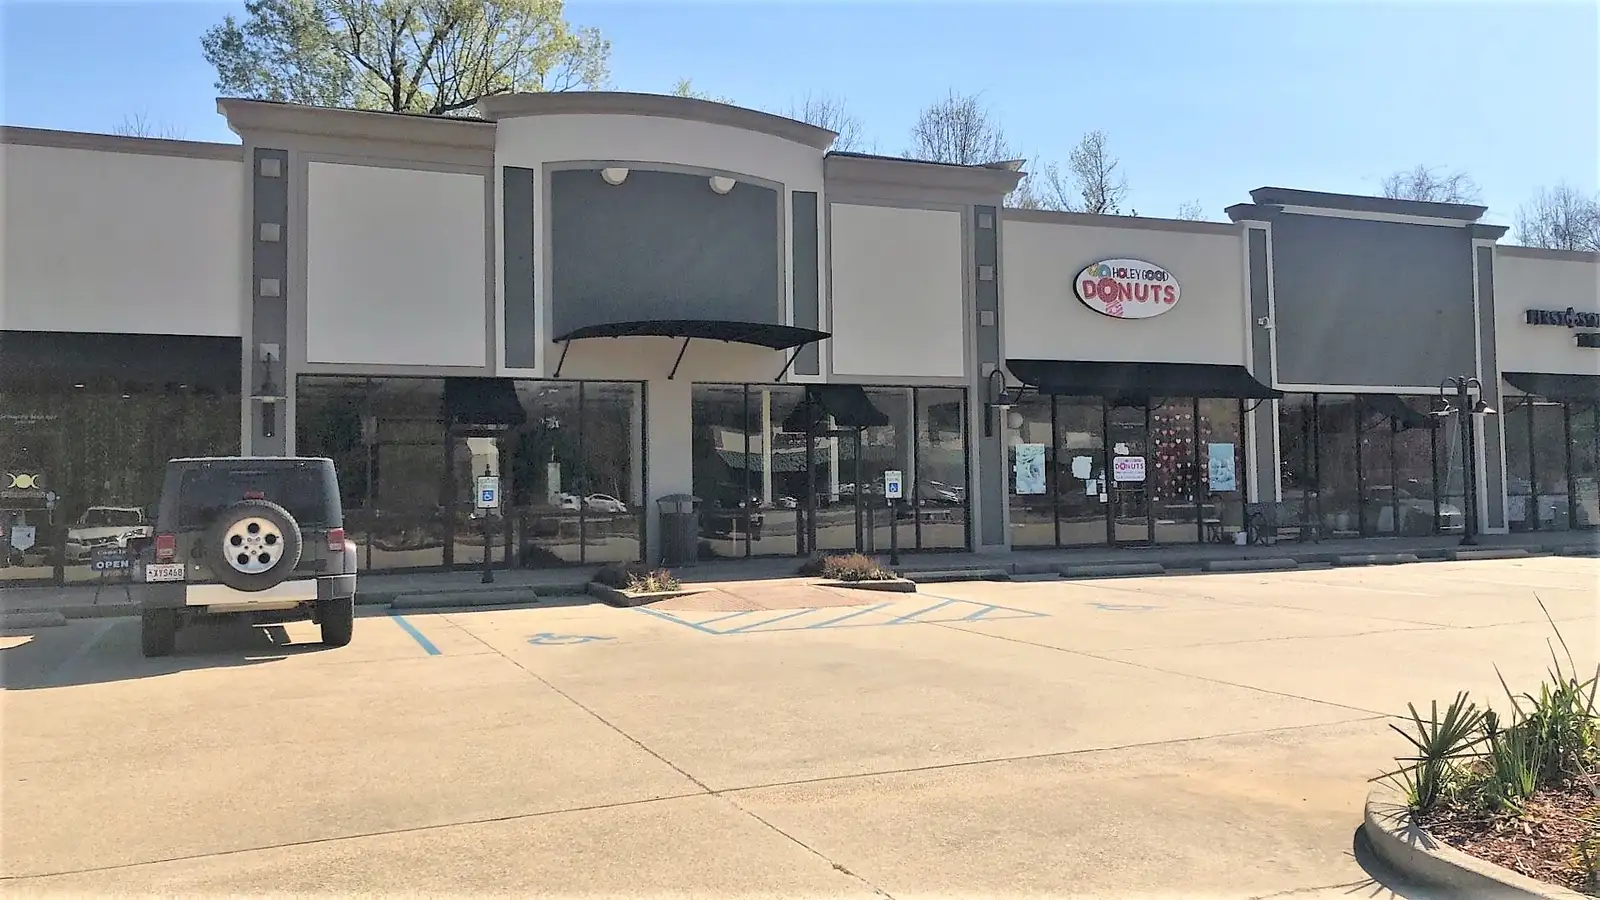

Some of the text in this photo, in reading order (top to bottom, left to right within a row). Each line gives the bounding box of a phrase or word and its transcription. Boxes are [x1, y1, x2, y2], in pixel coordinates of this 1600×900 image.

[1112, 267, 1169, 282] HOLEY GOOD
[1082, 277, 1175, 304] DONUTS
[1115, 462, 1144, 471] DONUTS
[96, 560, 129, 569] OPEN
